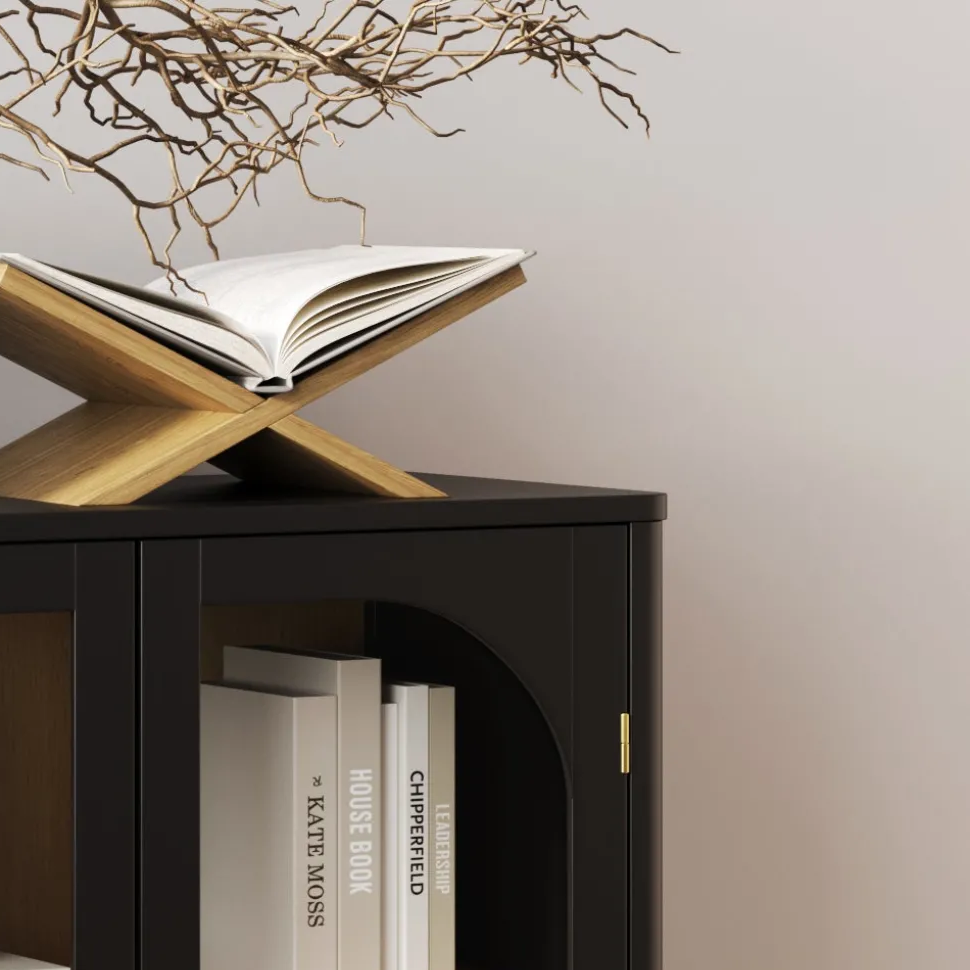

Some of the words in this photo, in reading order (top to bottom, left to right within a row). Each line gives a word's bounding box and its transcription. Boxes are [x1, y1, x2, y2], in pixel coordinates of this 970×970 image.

[307, 795, 325, 857] KATE
[349, 769, 373, 834] HOUSE
[410, 770, 425, 896] CHIPPERFIELD
[349, 841, 373, 895] BOOK
[435, 804, 451, 895] LEADERSHIP
[307, 864, 325, 928] MOSS
